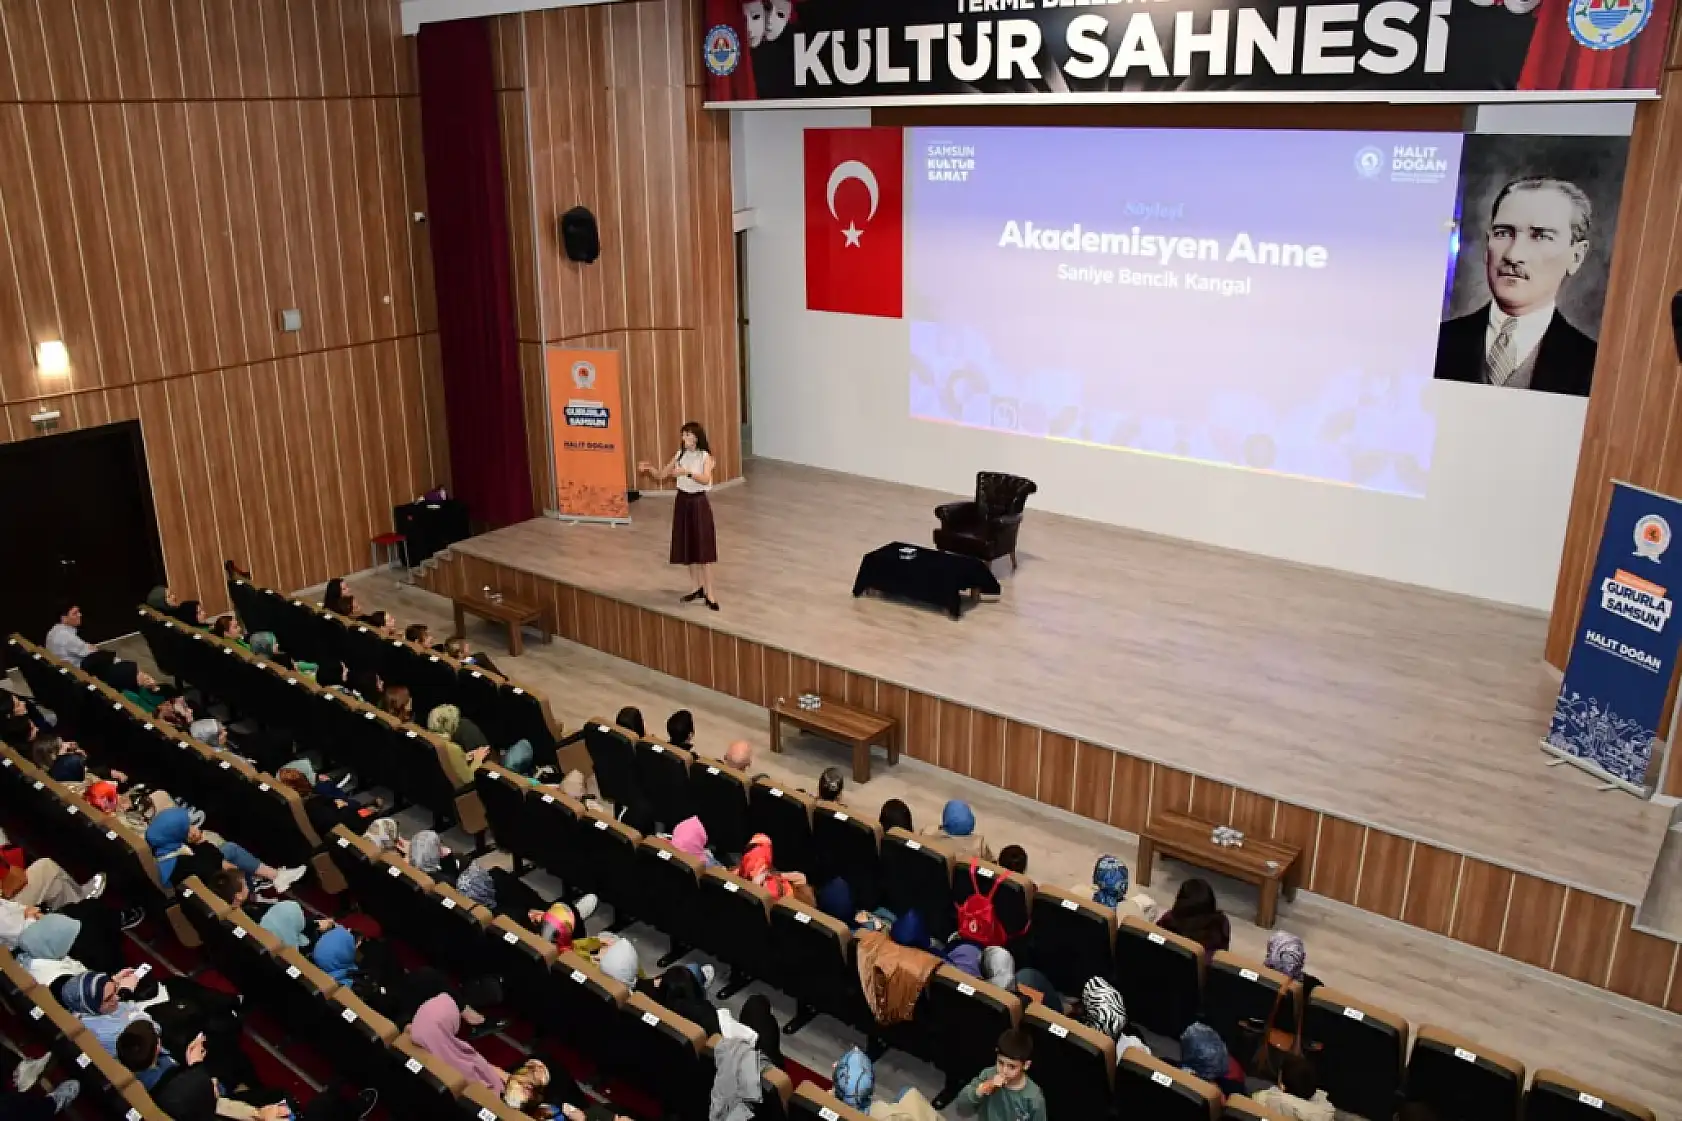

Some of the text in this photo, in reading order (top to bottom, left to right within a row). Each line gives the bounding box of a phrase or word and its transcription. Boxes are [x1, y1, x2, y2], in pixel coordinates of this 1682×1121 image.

[927, 144, 975, 157] SAMSUN
[927, 171, 968, 182] SANAT
[998, 220, 1328, 268] Akademisyen Anne
[1057, 263, 1252, 296] Saniye Bencik Kangal
[1607, 581, 1665, 613] GURURLA
[1607, 598, 1660, 627] SAMSUN
